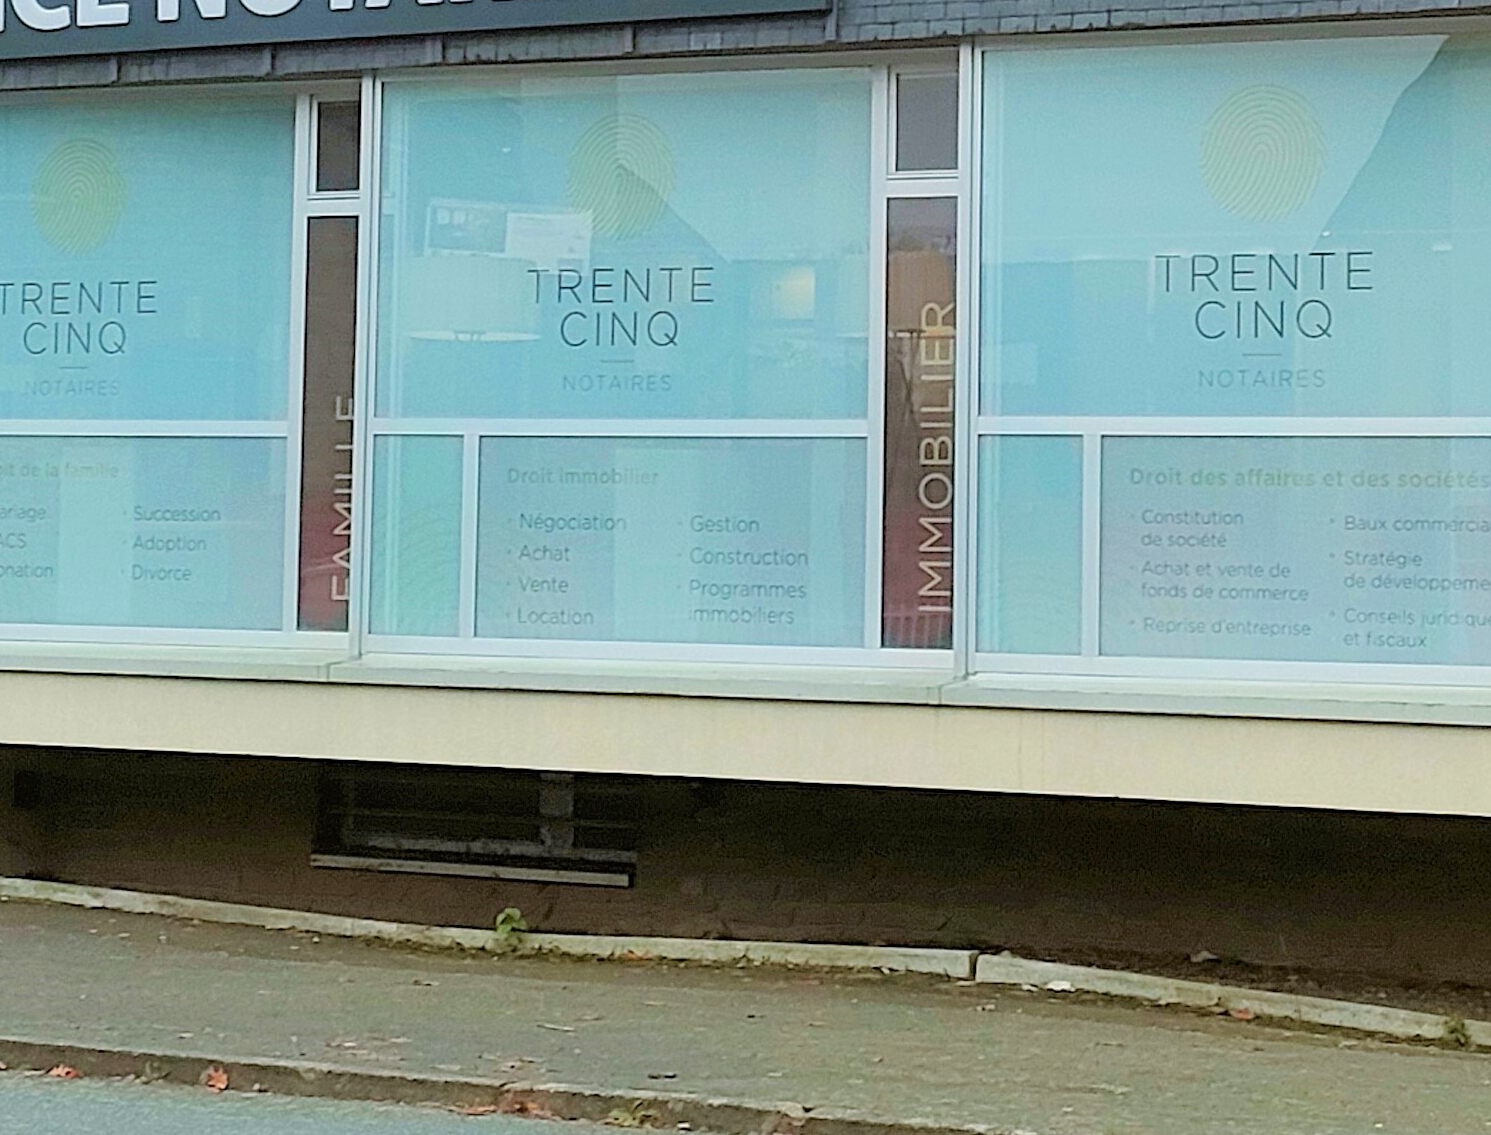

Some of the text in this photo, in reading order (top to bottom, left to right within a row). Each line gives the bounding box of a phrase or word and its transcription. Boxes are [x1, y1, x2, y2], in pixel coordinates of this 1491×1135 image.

[1154, 251, 1374, 293] TRENTE
[527, 267, 714, 304] TRENTE
[1194, 299, 1333, 340] CINQ
[560, 311, 678, 347] CINQ
[24, 321, 127, 356] CINQ
[562, 374, 672, 392] NOTAIRES
[1198, 369, 1326, 388] NOTAIRES
[25, 379, 120, 397] NOTAIRES
[917, 302, 955, 612] IMMOBILIER
[20, 462, 39, 478] de
[508, 467, 659, 485] Droit immobilier
[1130, 468, 1490, 489] Droit des affaires et des sociétés
[133, 505, 221, 522] Succession
[1141, 509, 1243, 525] Constitution
[519, 513, 626, 533] Négociation
[690, 515, 759, 533] Gestion
[1344, 516, 1387, 530] Baux
[132, 536, 207, 553] Adoption
[1141, 532, 1227, 547] de société
[518, 544, 570, 562] Achat
[689, 547, 808, 566] Construction
[1344, 550, 1422, 569] Stratégie
[131, 564, 192, 581] Divorce
[1141, 561, 1291, 578] Achat et vente de
[518, 576, 569, 593] Vente
[689, 579, 807, 600] Programmes
[1344, 574, 1365, 588] de
[1141, 582, 1309, 601] fonds de commerce
[517, 607, 594, 625] Location
[689, 606, 795, 625] immobiliers
[1344, 608, 1415, 624] Conseils
[1143, 617, 1311, 637] Reprise d'entreprise
[1343, 632, 1427, 647] et fiscaux
